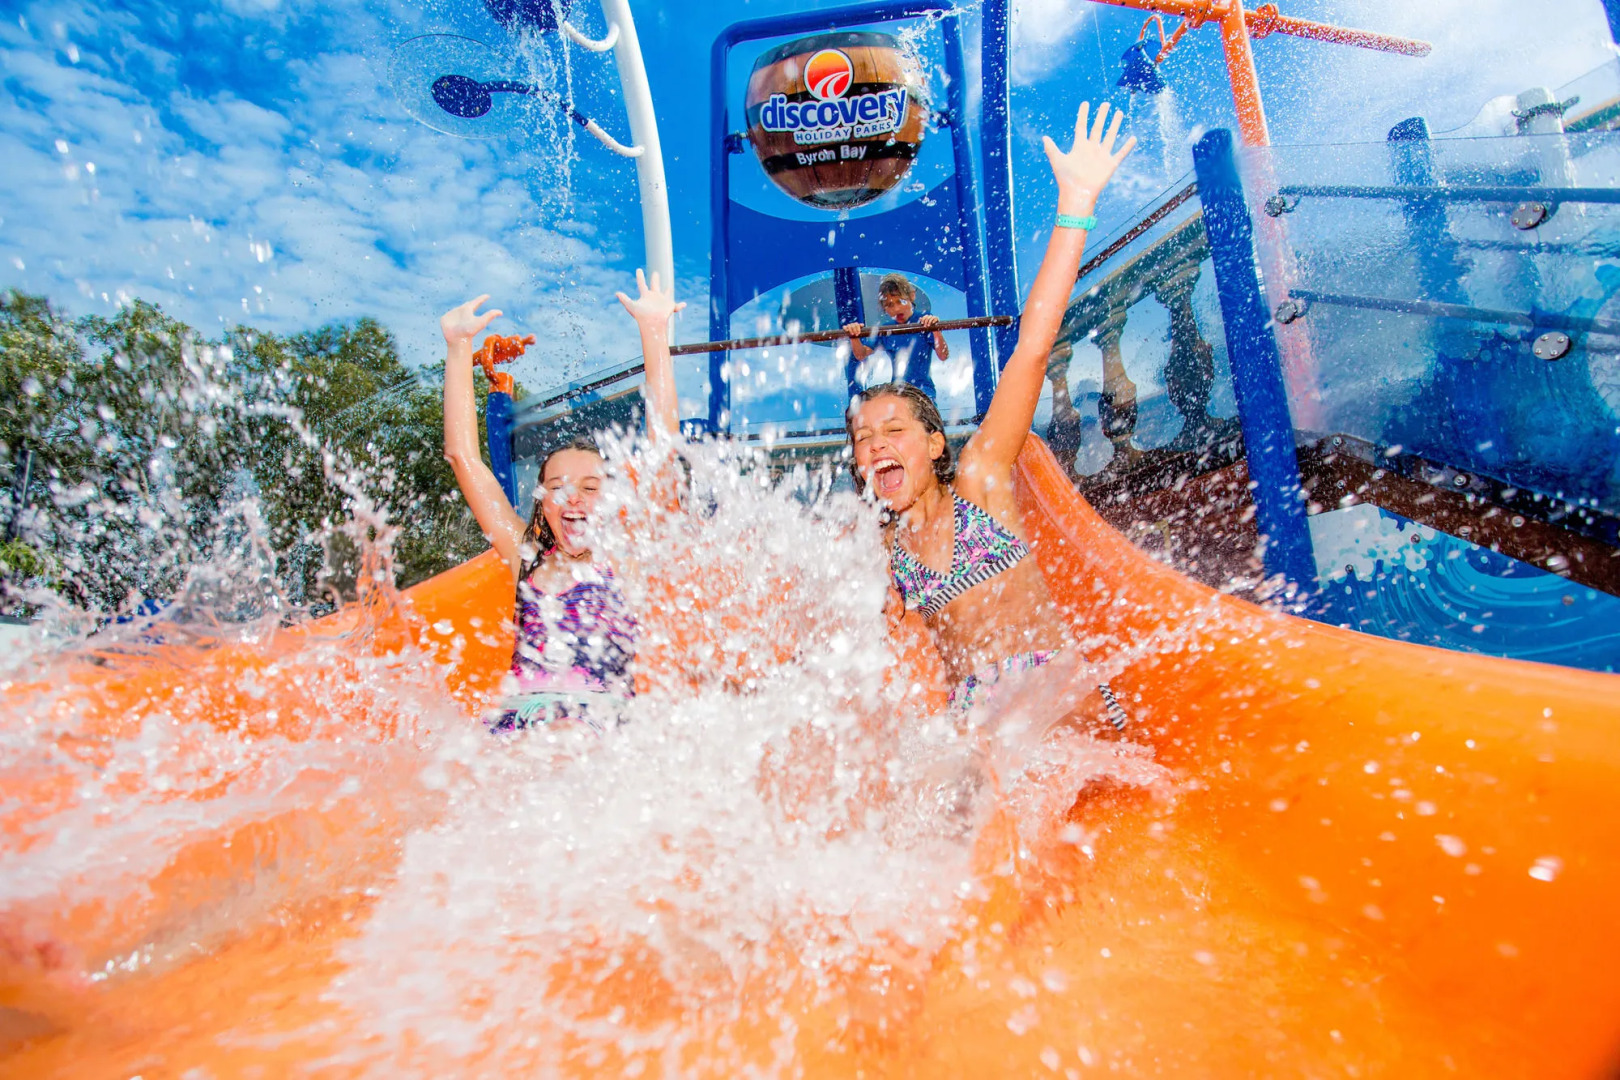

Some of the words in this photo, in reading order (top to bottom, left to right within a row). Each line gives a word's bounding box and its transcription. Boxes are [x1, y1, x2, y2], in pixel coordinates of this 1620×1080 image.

[762, 88, 907, 129] discovery
[796, 129, 850, 141] HOLIDAY
[856, 122, 892, 135] PARKS
[796, 148, 836, 166] Byron
[840, 145, 868, 160] Bay
